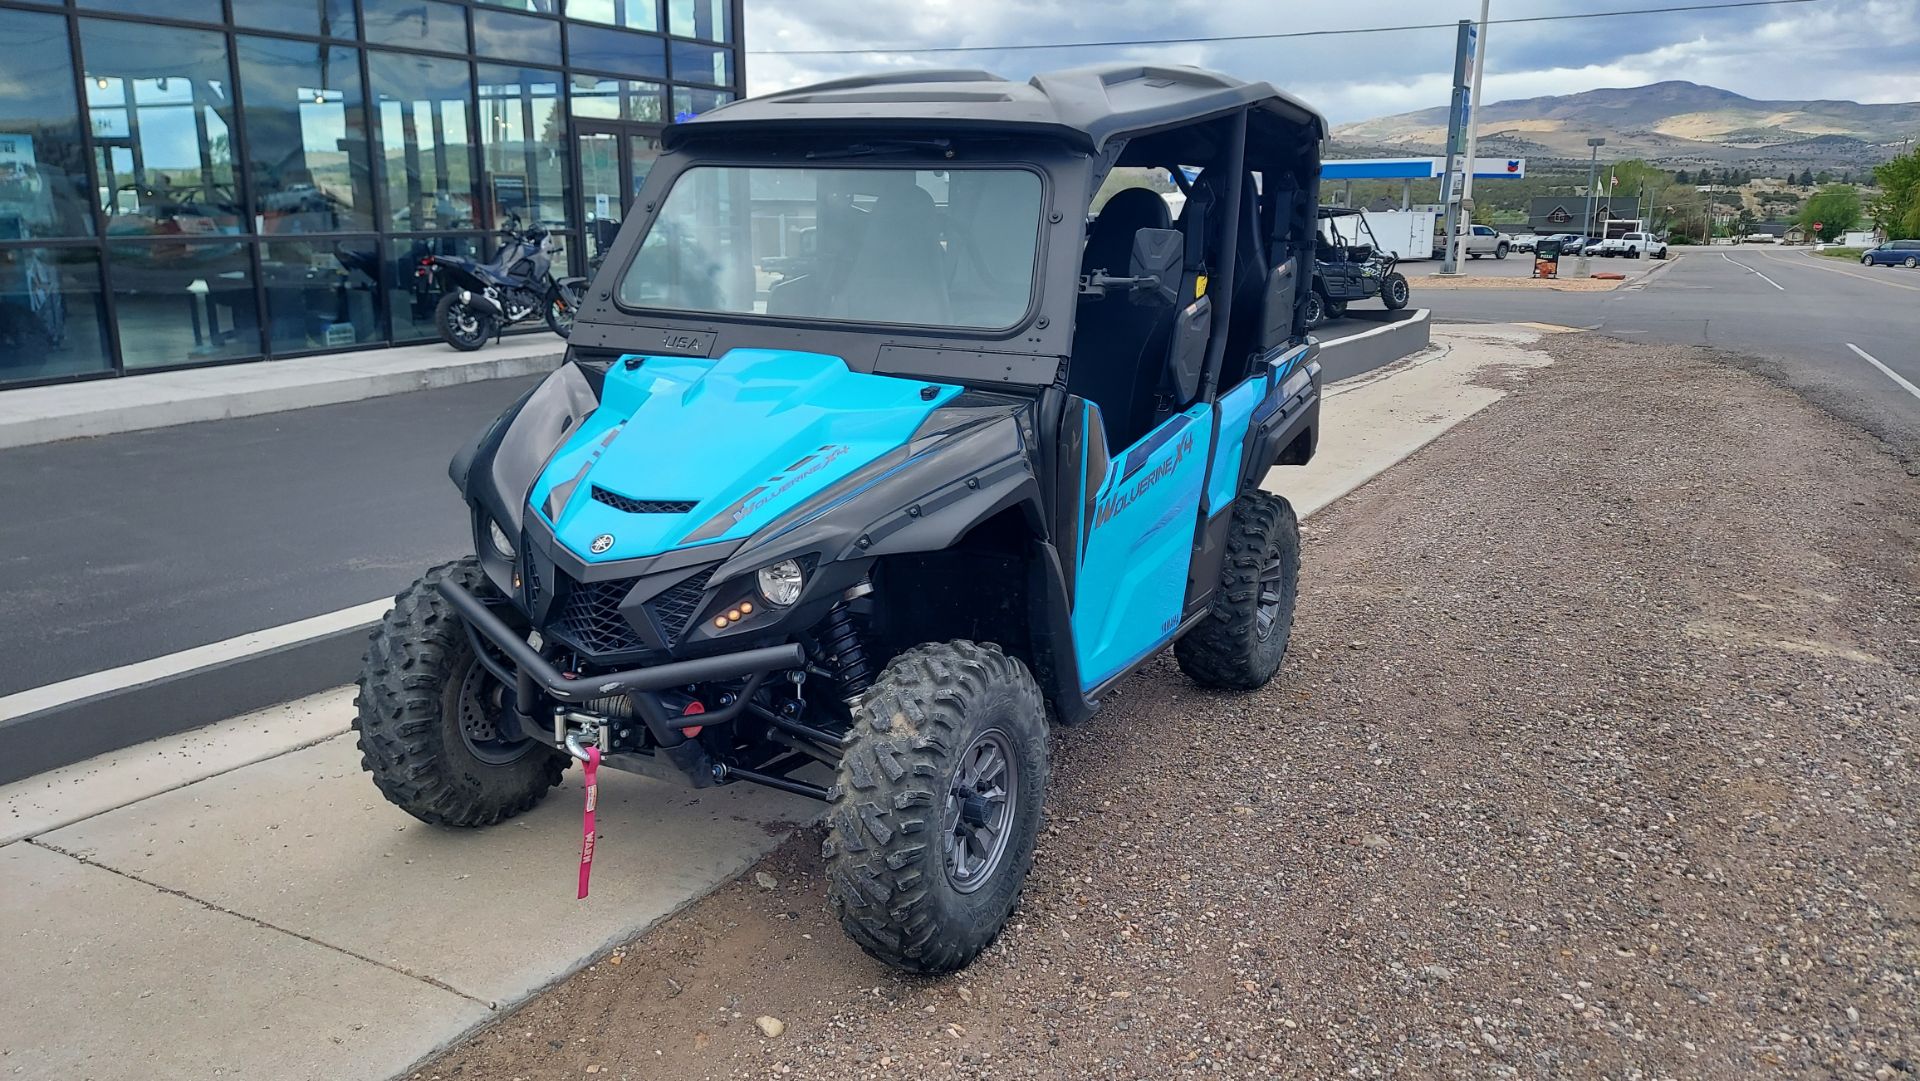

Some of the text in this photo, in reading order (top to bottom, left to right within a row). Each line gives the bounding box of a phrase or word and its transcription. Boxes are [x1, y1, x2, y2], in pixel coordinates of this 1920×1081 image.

[665, 335, 699, 350] USA
[733, 462, 827, 522] WOLVERINE
[1095, 456, 1173, 529] WOLVERINE
[582, 831, 595, 864] WARN
